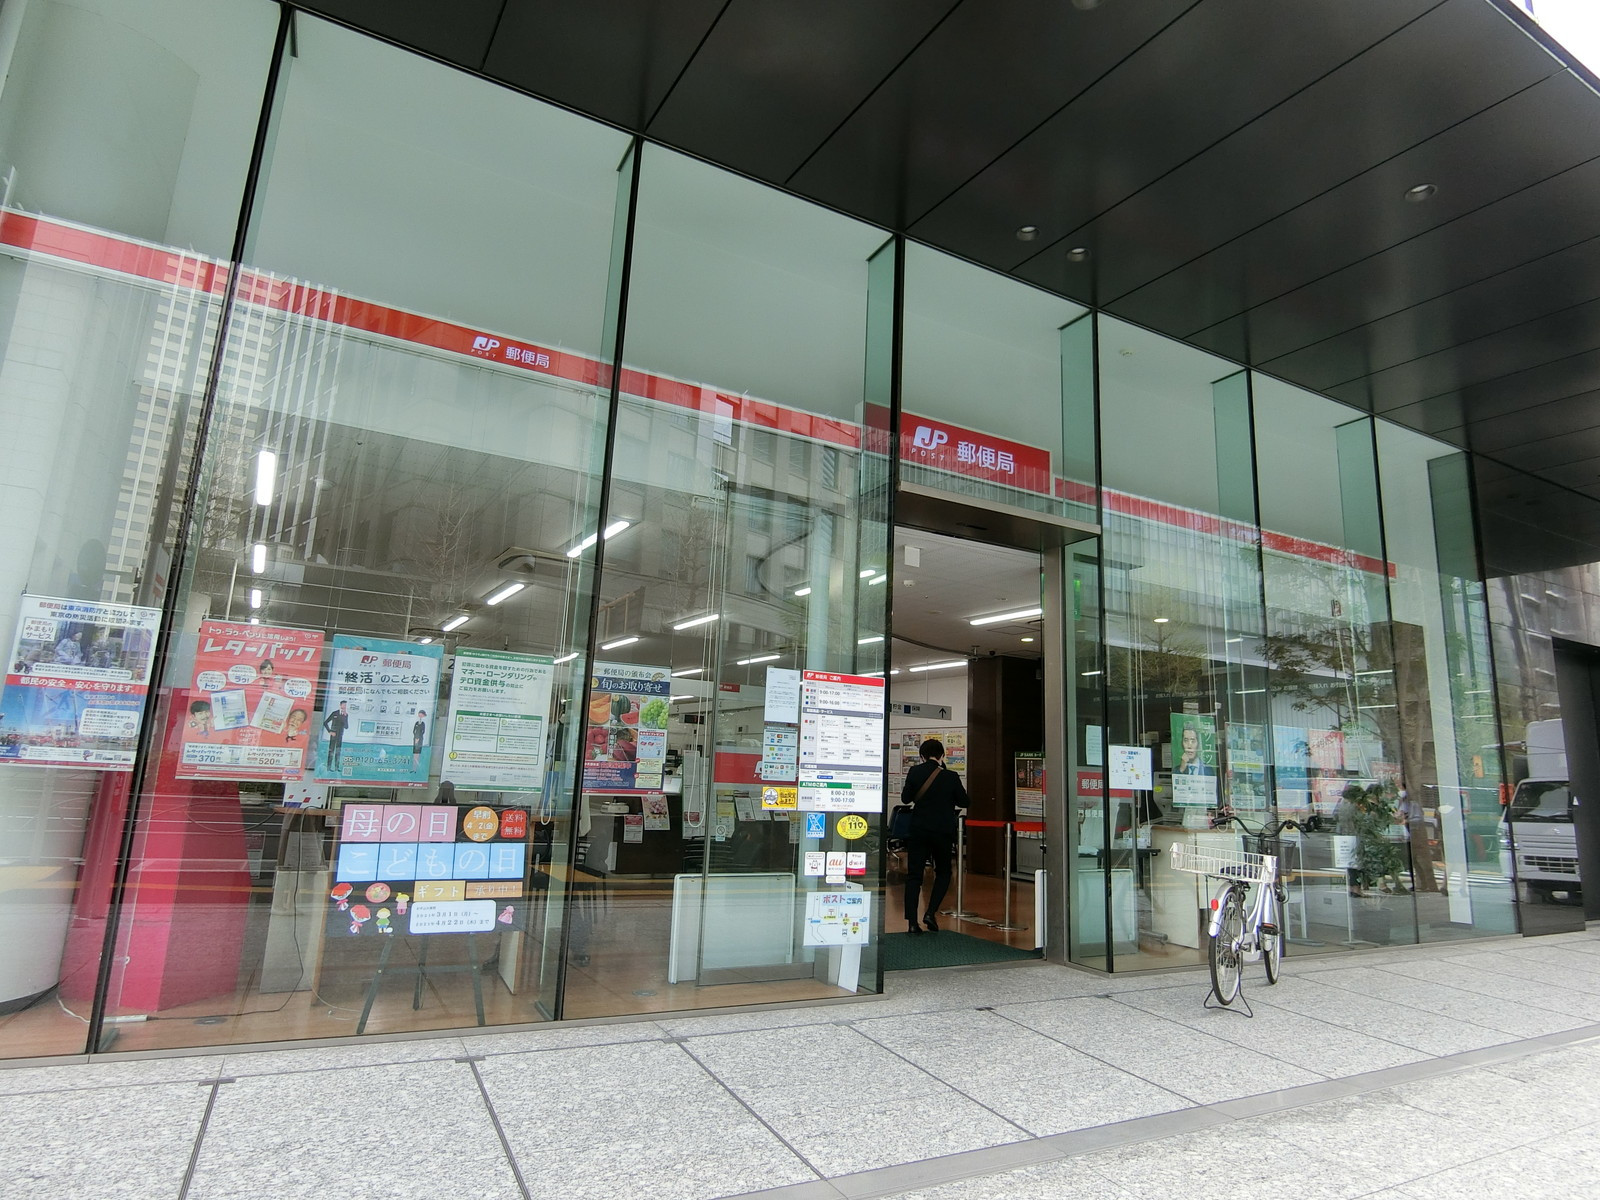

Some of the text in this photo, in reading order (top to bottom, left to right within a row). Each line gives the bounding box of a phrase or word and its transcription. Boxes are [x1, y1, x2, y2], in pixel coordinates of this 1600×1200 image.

[470, 349, 496, 358] POST
[505, 346, 550, 369] 郵便局
[911, 447, 945, 461] POST
[957, 440, 1015, 475] 郵便局
[25, 624, 54, 633] みまもり
[26, 632, 52, 640] サービス
[203, 638, 317, 662] レターパック
[382, 659, 412, 670] 郵便局
[447, 658, 455, 670] 2
[20, 677, 135, 693] 都民の安全・安心を守ります。
[338, 686, 431, 695] 郵便局になんでもご相談ください
[600, 678, 663, 693] 旬のお取り寄せ
[1203, 721, 1213, 764] コツコツ
[198, 755, 221, 763] 370円
[473, 810, 491, 819] 早割
[505, 813, 524, 823] 送料
[346, 808, 449, 839] 母の日
[472, 832, 487, 840] まで
[504, 826, 523, 836] 無料
[345, 848, 517, 879] こどもの日
[828, 859, 844, 867] au
[418, 884, 459, 898] ギフト
[823, 894, 863, 905] ポスト ご案内
